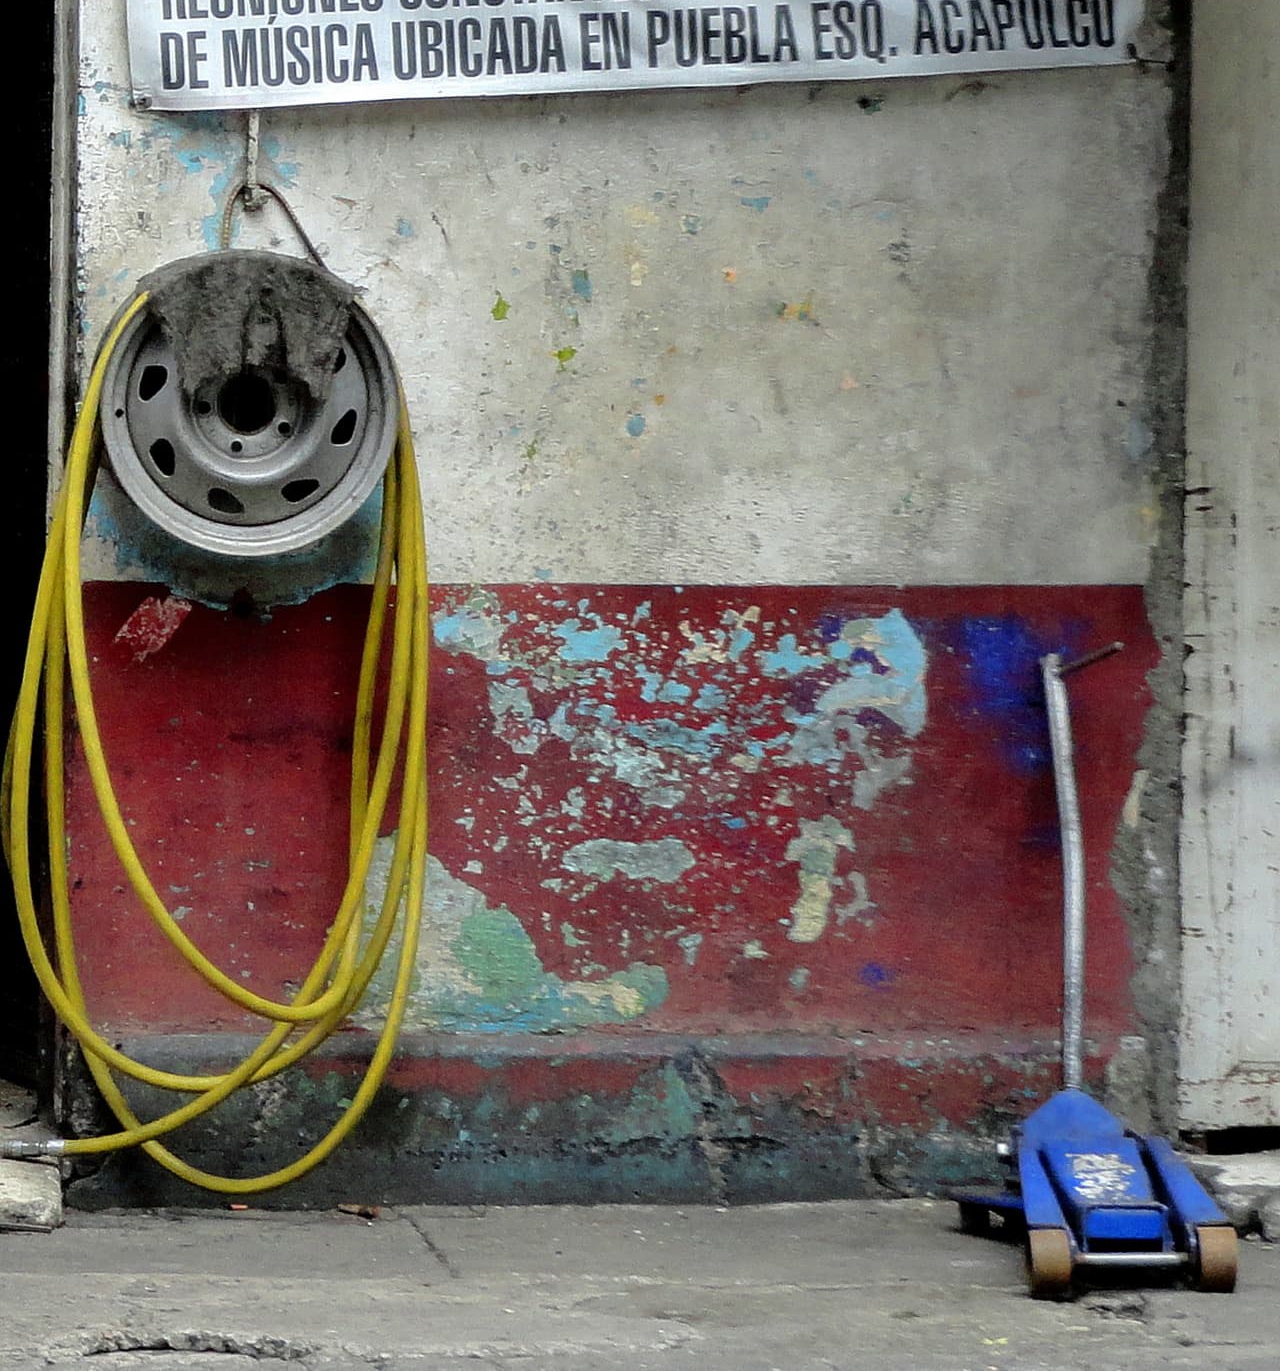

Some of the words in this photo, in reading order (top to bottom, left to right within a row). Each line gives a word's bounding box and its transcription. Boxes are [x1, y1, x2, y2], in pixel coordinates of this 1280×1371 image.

[160, 30, 209, 90] DE
[223, 16, 380, 89] MÚSICA
[393, 15, 566, 80] UBICADA
[580, 12, 631, 71] EN
[647, 4, 798, 69] PUEBLA
[812, 0, 898, 63] ESQ.
